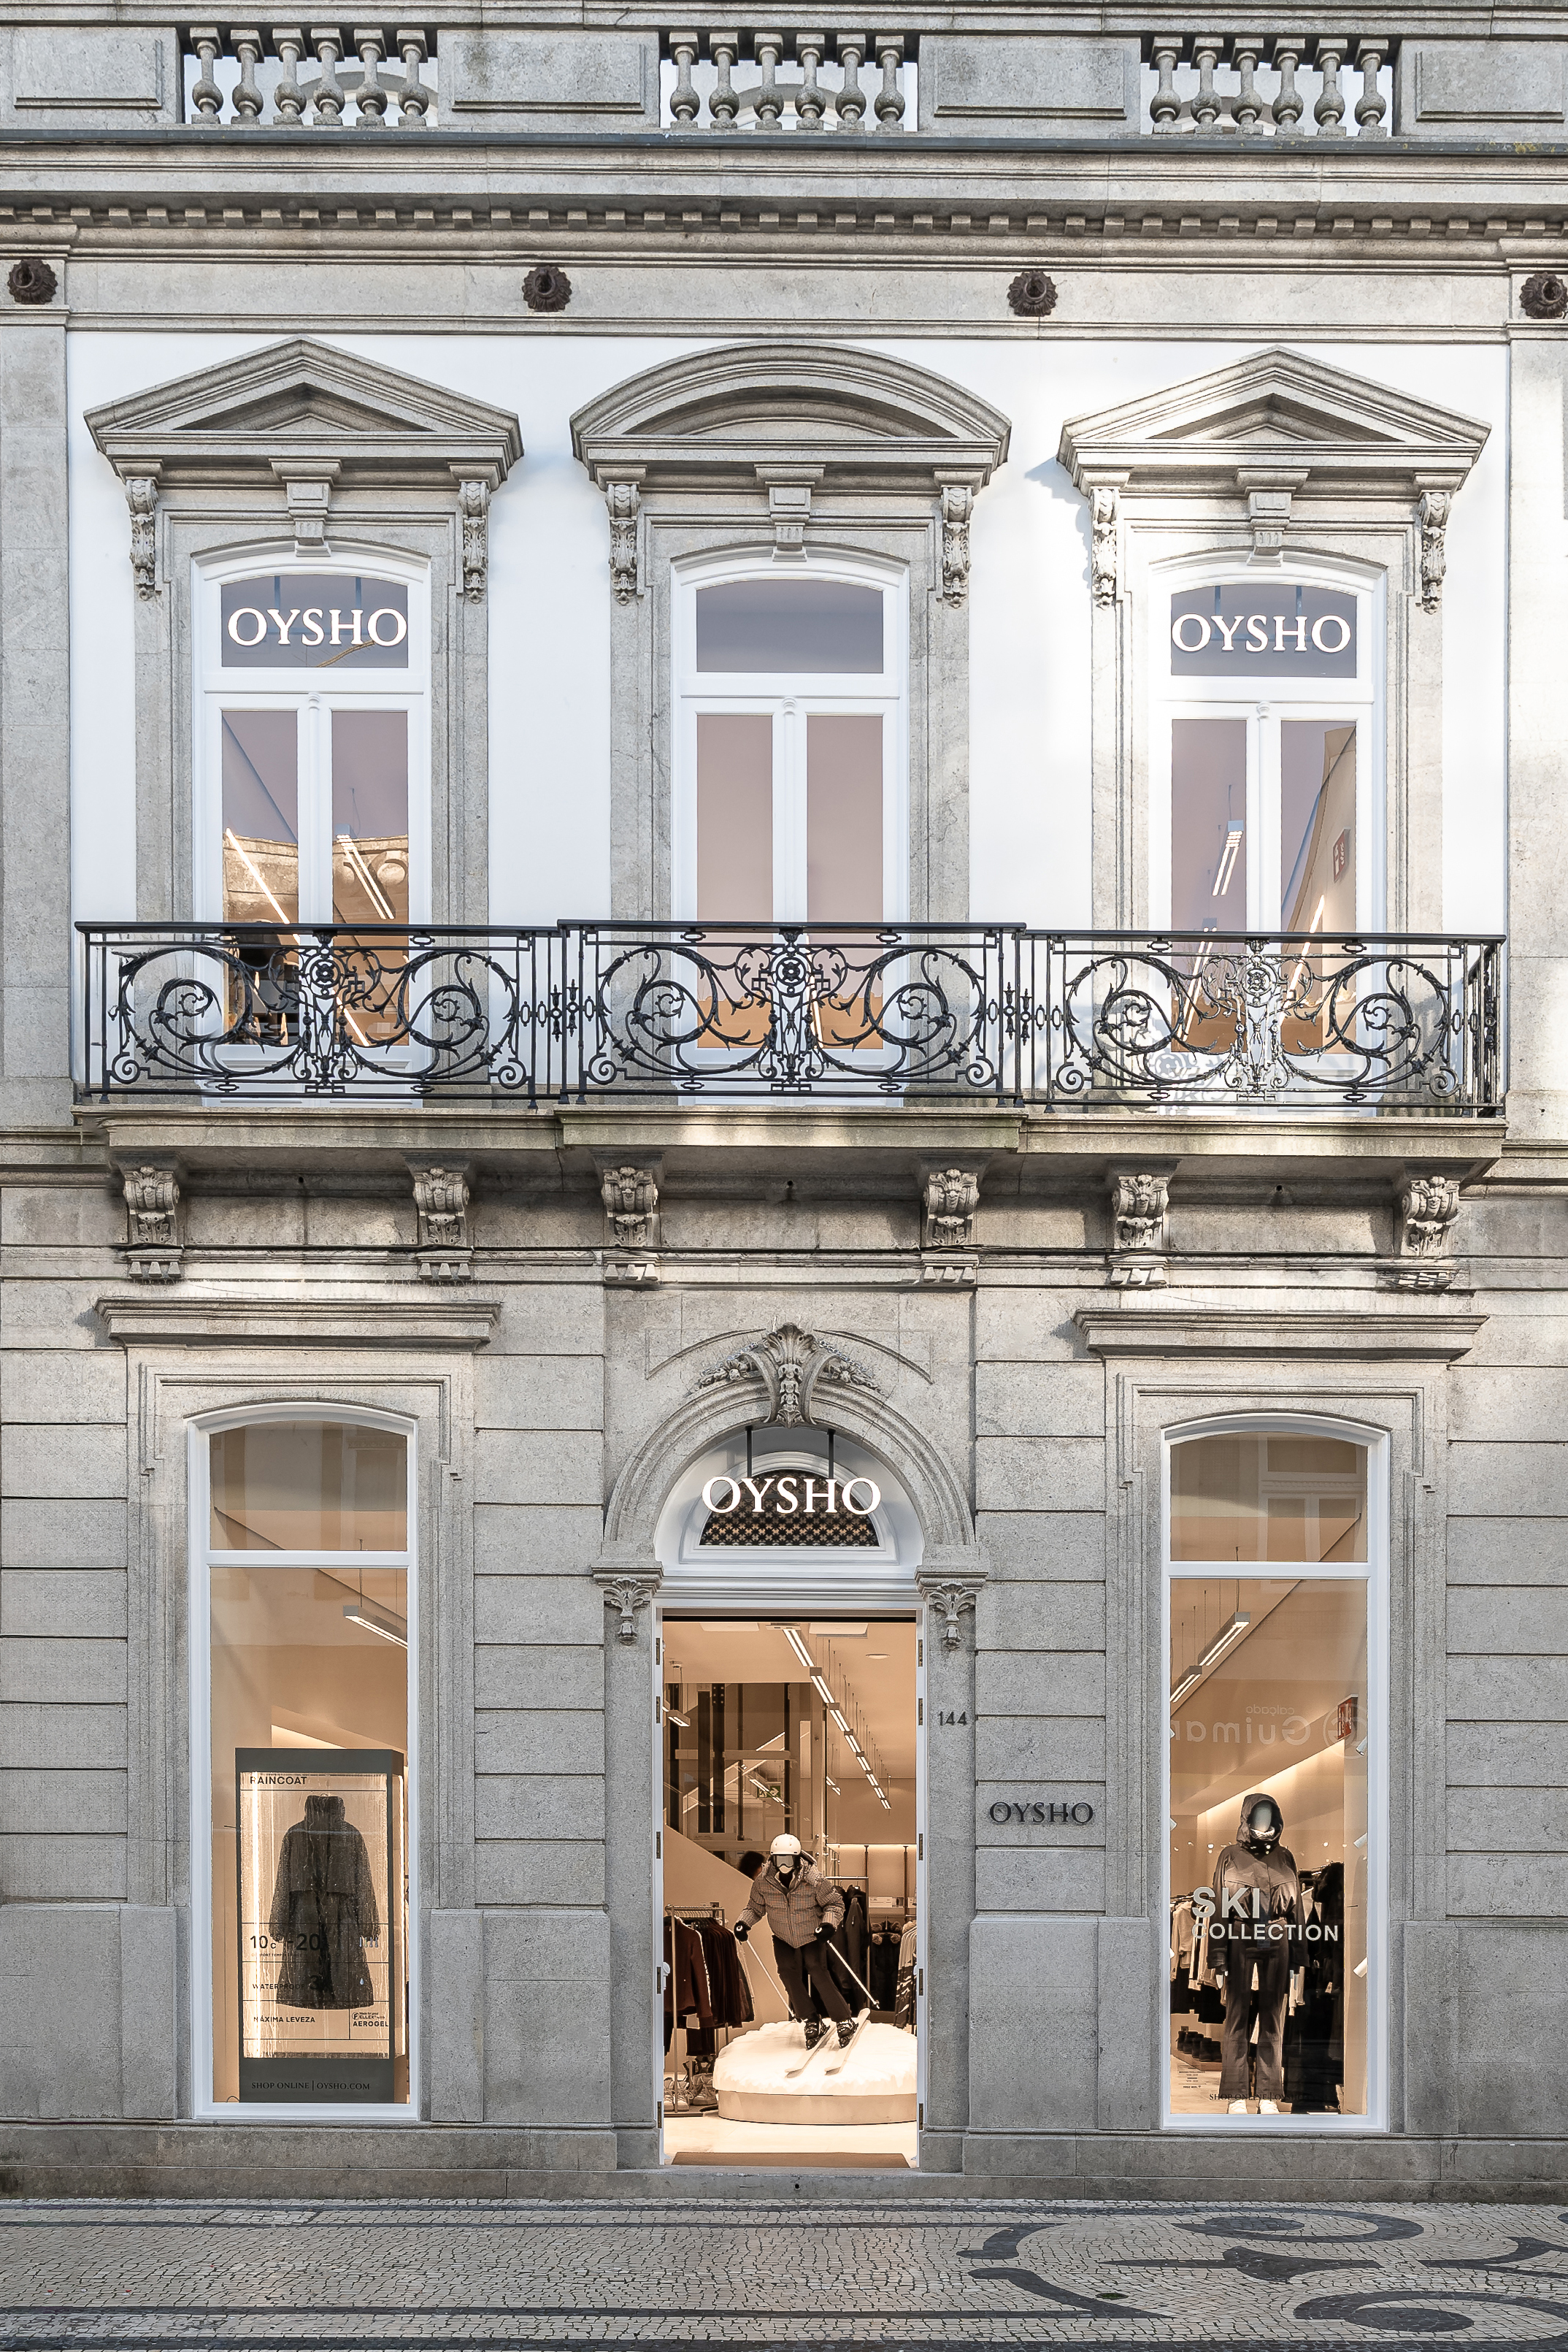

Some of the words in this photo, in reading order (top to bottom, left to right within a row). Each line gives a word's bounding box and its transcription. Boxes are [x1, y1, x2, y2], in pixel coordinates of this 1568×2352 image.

[227, 608, 407, 647] OYSHO
[1172, 613, 1351, 653] OYSHO
[702, 1475, 882, 1515] OYSHO
[938, 1711, 968, 1726] 144
[250, 1776, 308, 1785] RAINCOAT
[989, 1801, 1094, 1824] OYSHO
[1192, 1886, 1260, 1919] SKI
[1192, 1923, 1339, 1942] COLLECTION
[316, 2083, 370, 2091] OYSHO.COM
